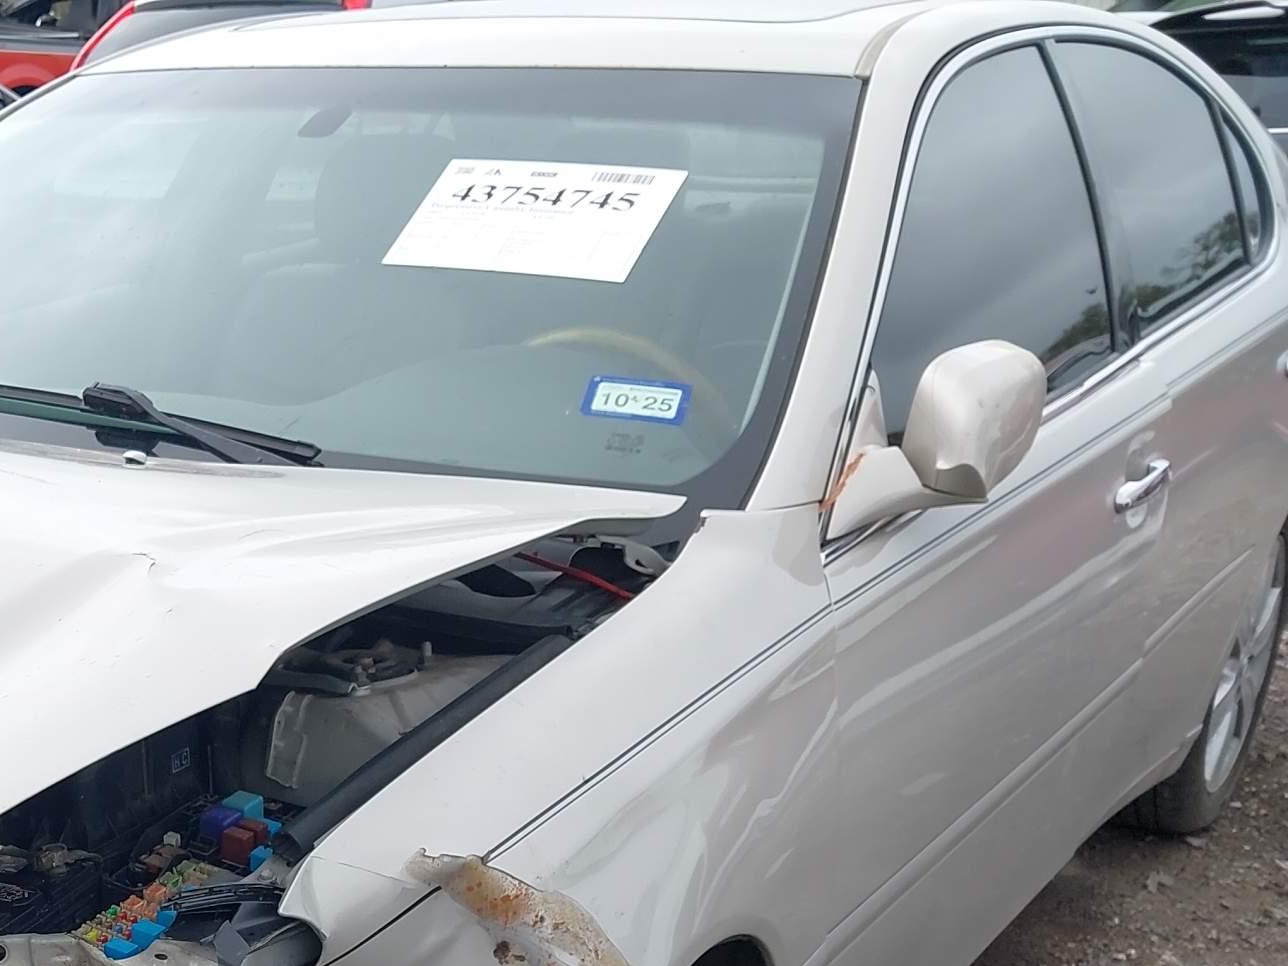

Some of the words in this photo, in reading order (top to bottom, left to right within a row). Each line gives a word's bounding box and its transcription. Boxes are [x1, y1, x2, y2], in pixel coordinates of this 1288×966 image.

[452, 184, 640, 211] 43754745
[602, 391, 630, 408] 10
[641, 396, 675, 413] 25
